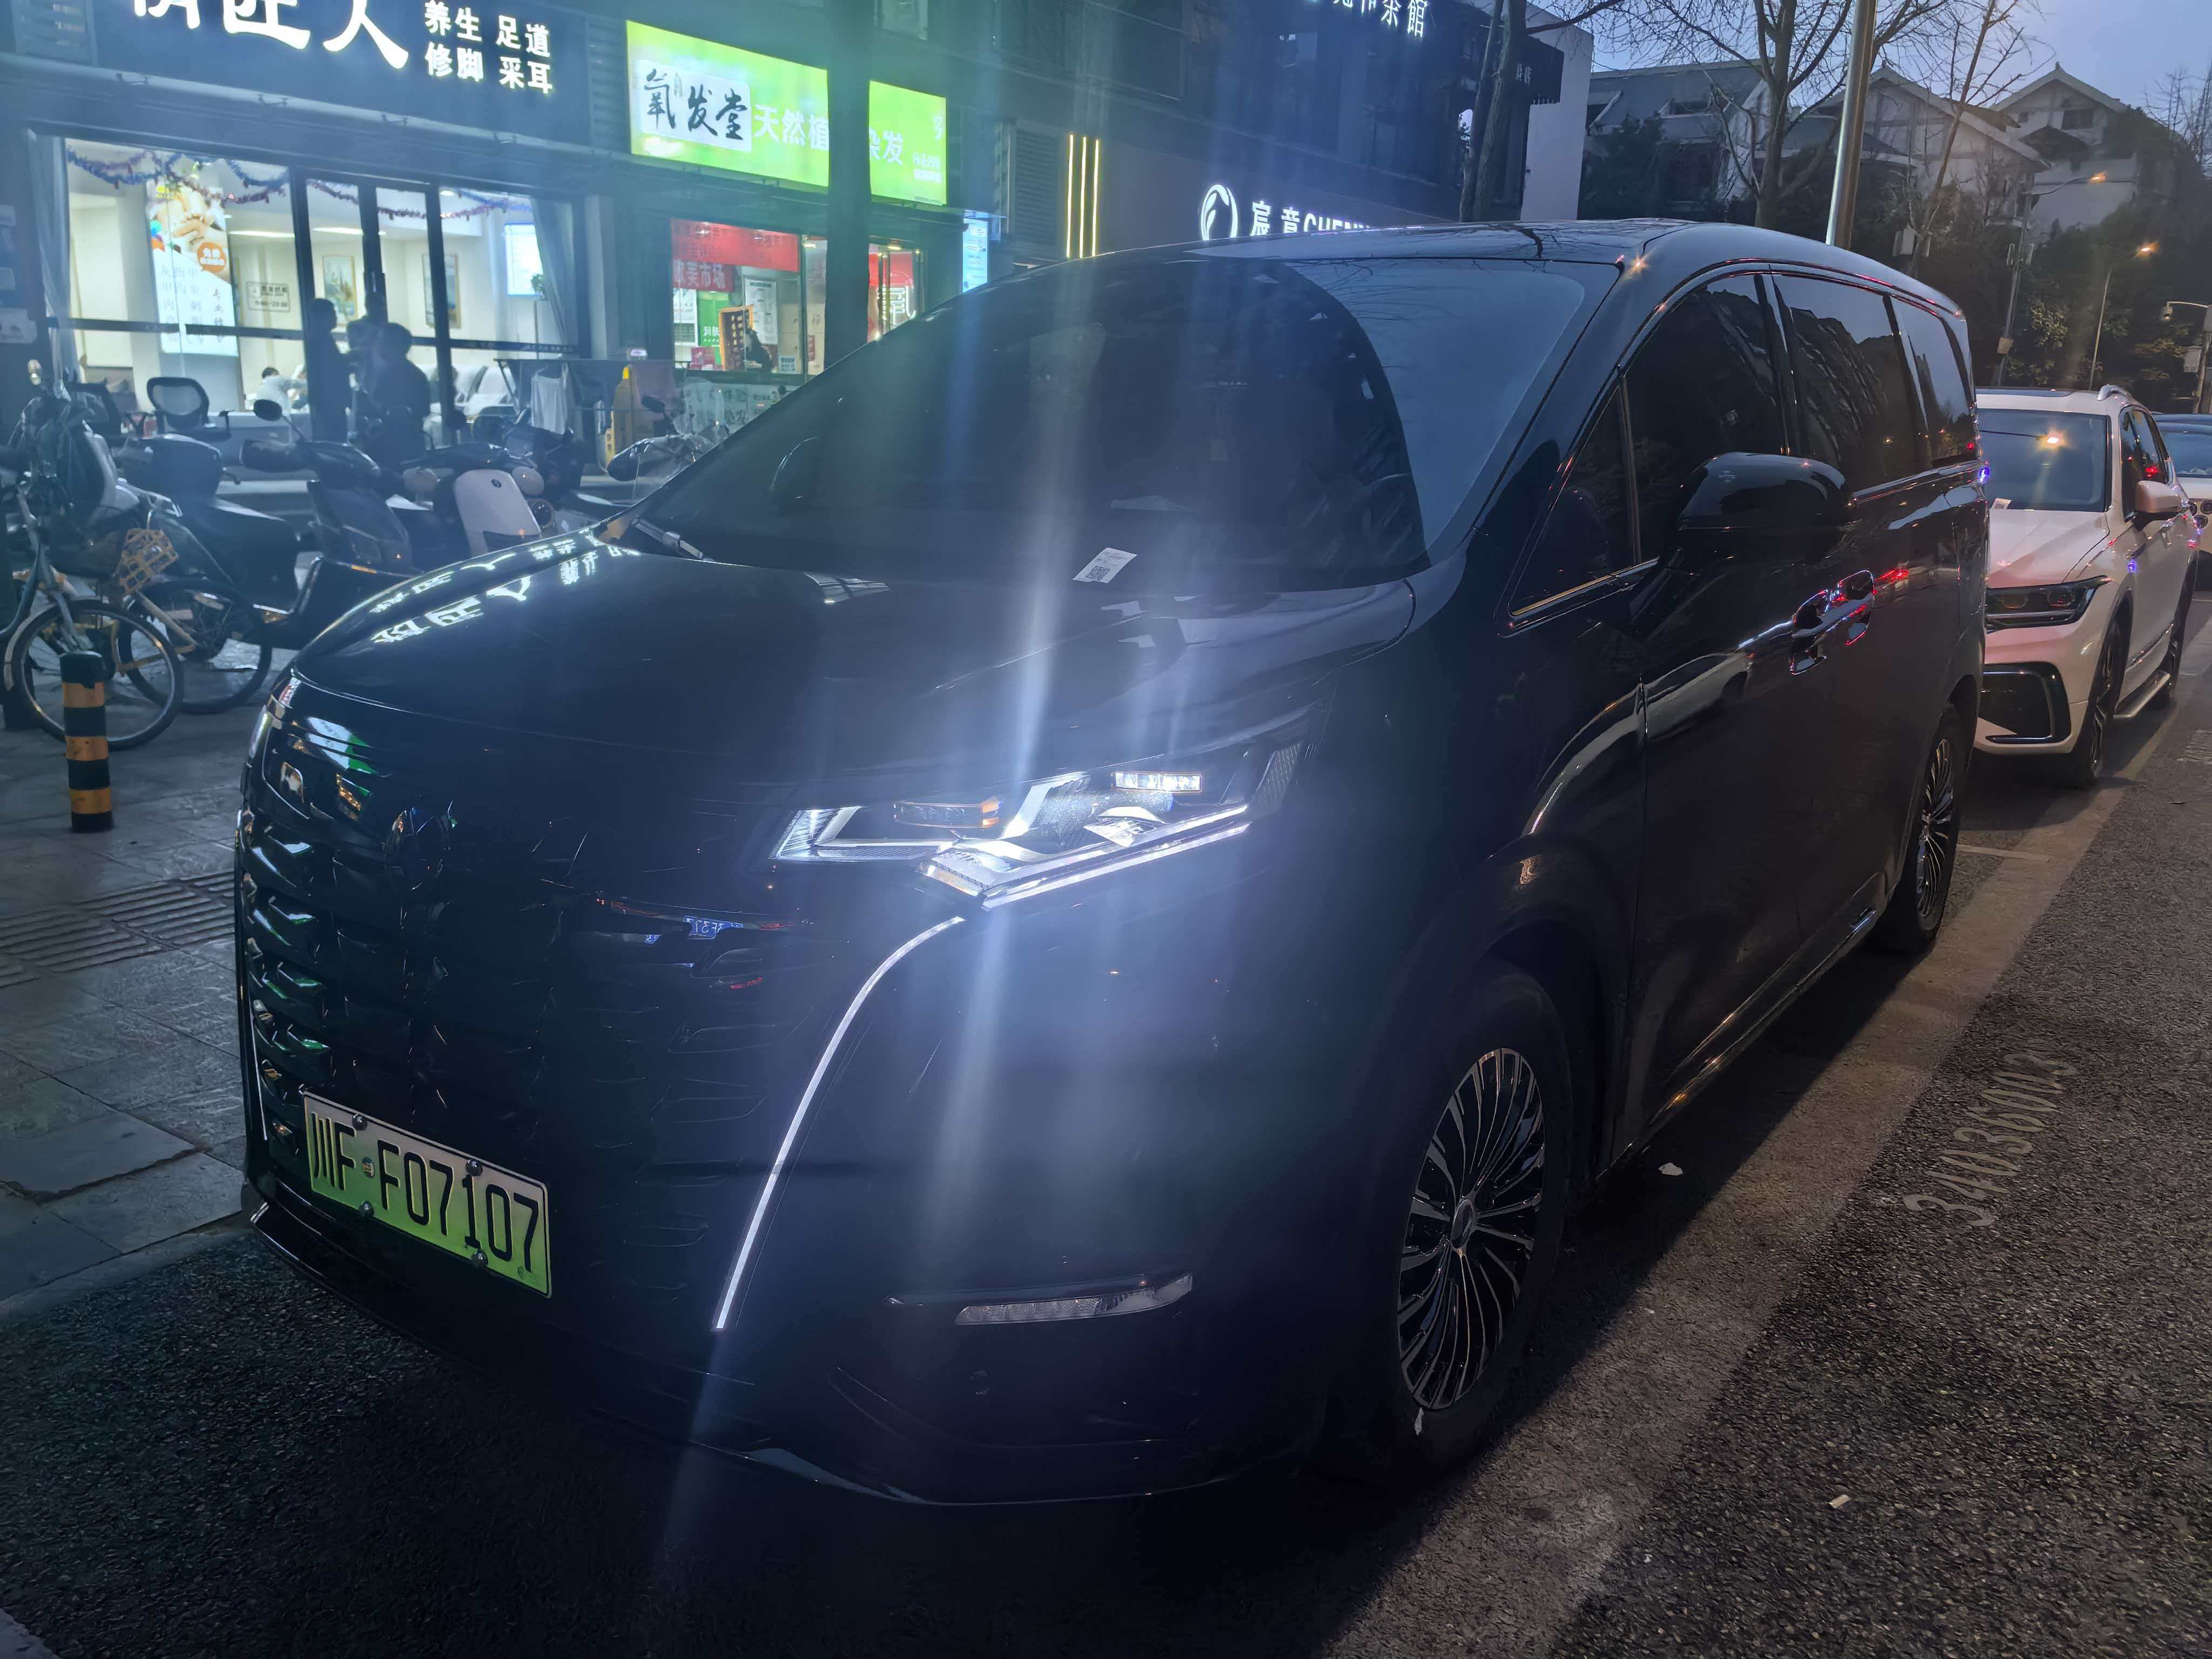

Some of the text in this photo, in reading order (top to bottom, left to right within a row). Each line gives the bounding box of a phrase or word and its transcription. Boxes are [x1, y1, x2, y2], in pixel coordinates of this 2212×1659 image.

[424, 0, 550, 57] 养生 足道
[424, 42, 552, 94] 修脚 采耳
[377, 1139, 539, 1273] F07107
